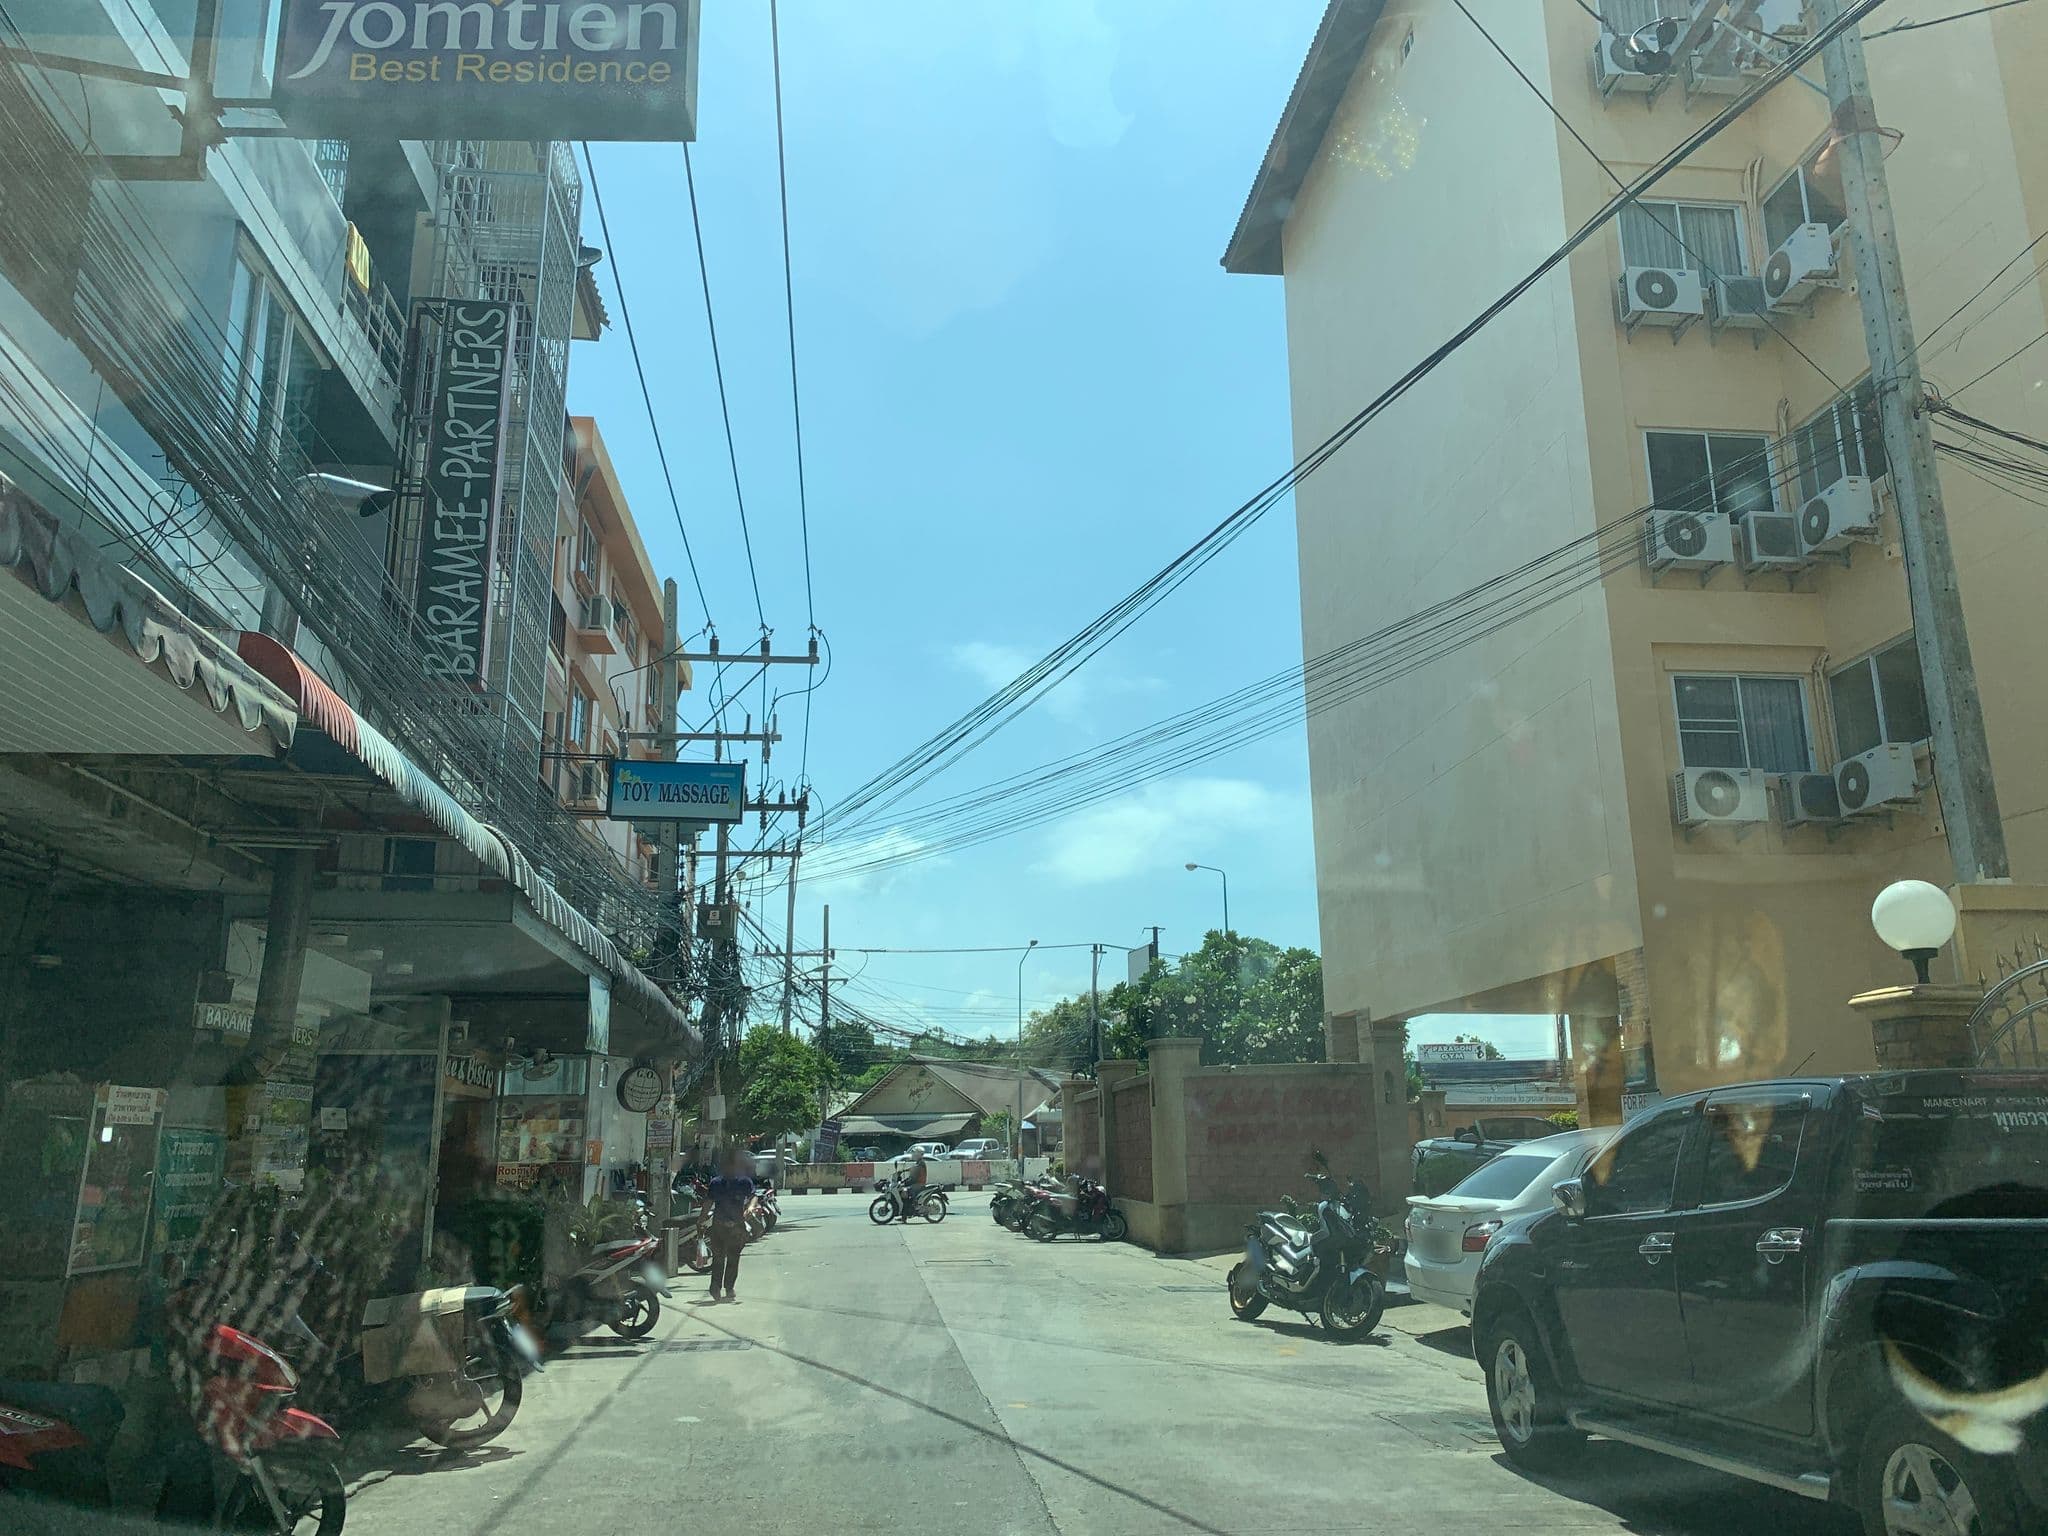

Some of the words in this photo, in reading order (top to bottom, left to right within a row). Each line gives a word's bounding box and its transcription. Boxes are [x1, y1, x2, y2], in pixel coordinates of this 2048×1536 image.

[349, 53, 442, 82] Best
[455, 53, 672, 83] Residence
[422, 305, 507, 676] BARAMEE-PARTNERS
[622, 781, 653, 802] TOY
[658, 783, 730, 805] MASSAGE
[1431, 1044, 1473, 1052] PARAGON
[1440, 1052, 1465, 1060] GYM
[466, 1056, 494, 1089] Bistro
[1623, 1095, 1637, 1110] FOR
